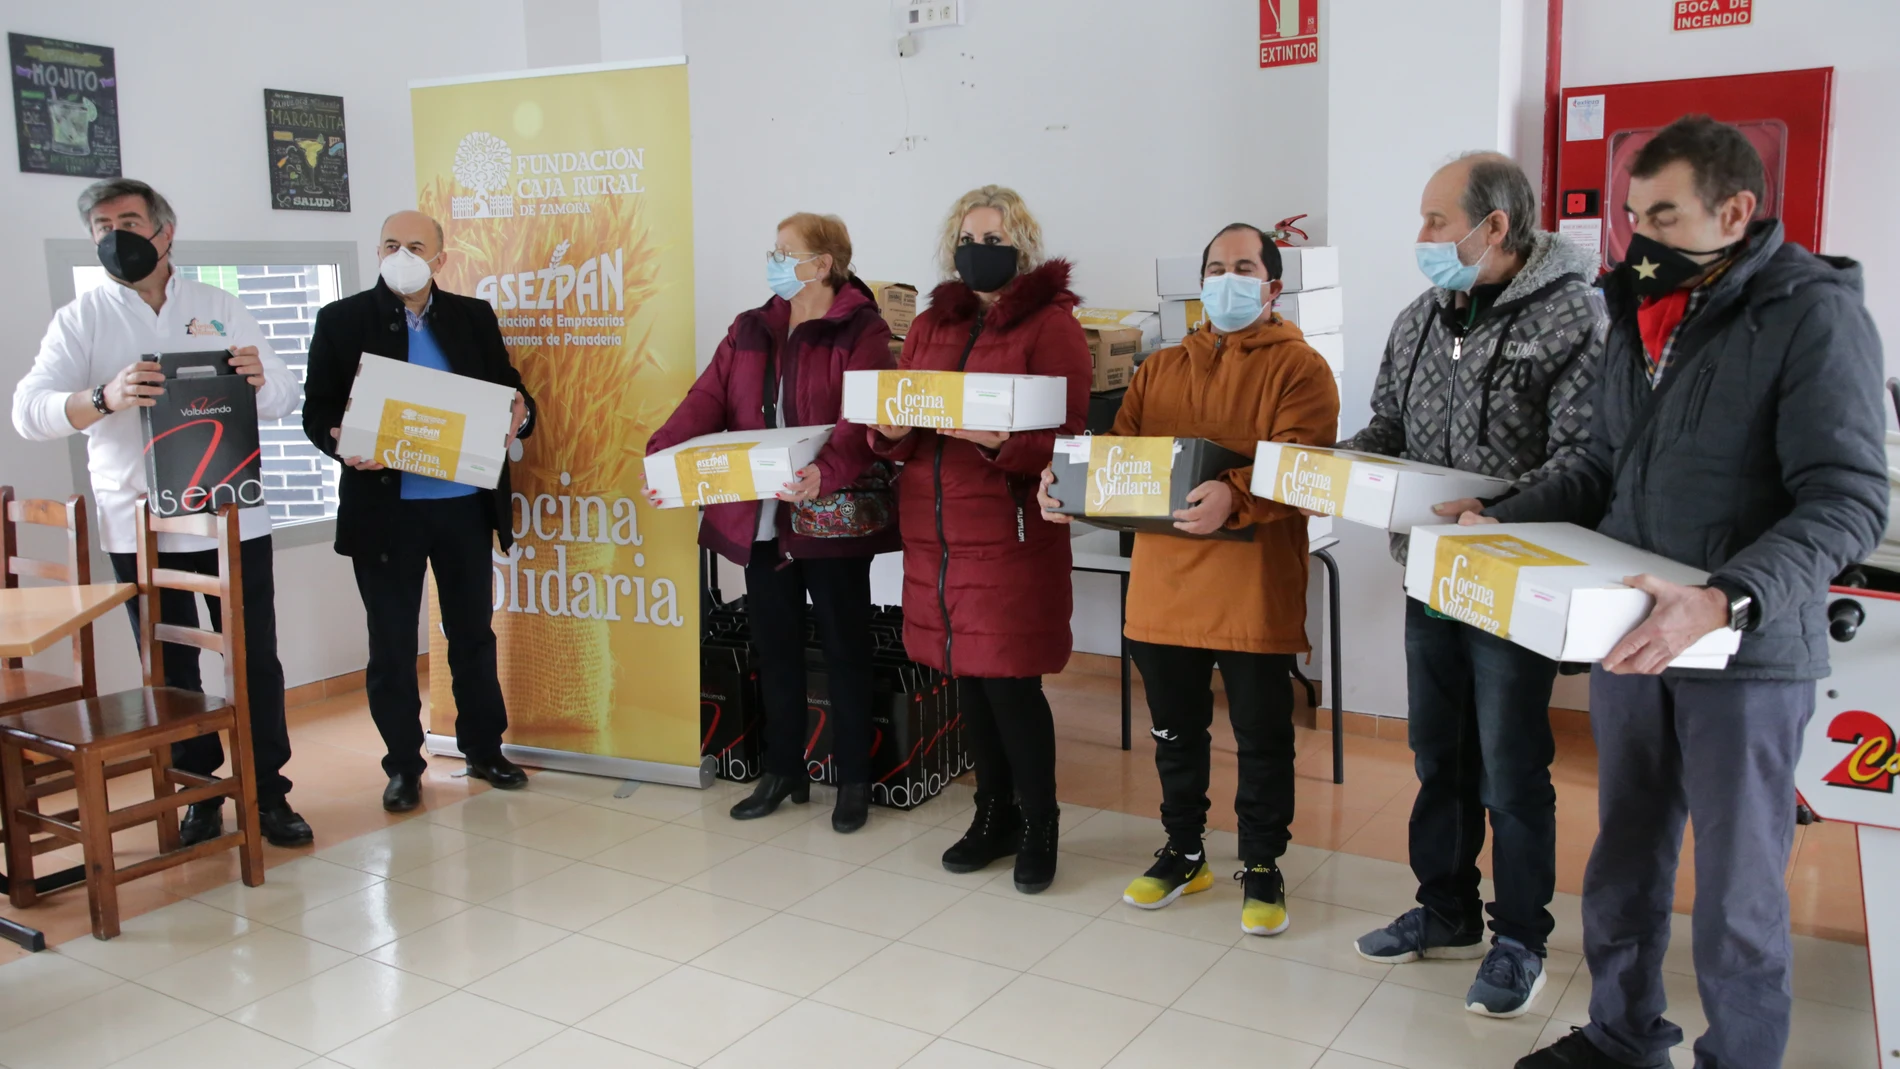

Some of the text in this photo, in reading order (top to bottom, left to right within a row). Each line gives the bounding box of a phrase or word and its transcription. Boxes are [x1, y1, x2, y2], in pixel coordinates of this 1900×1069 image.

[1677, 11, 1749, 29] INCENDIO
[1678, 0, 1749, 14] BOCA DE
[1261, 42, 1317, 63] EXTINTOR
[32, 63, 98, 92] MOJITO
[270, 109, 344, 130] MARGARITA
[516, 148, 645, 175] FUNDACIÓN
[517, 174, 645, 200] CAJA RURAL
[293, 196, 335, 208] SALUD!
[520, 202, 591, 216] DE ZAMORA
[539, 314, 553, 328] de
[557, 314, 625, 330] Empresarios
[546, 333, 560, 346] de
[897, 377, 944, 414] Cocina
[180, 404, 232, 417] Valbusenda
[885, 397, 954, 429] Solidaria
[383, 449, 448, 479] Solidaria
[394, 439, 440, 465] Cocina
[1107, 446, 1152, 483] Cocina
[1291, 451, 1332, 491] Cocina
[1093, 467, 1162, 509] Solidaria
[1281, 471, 1336, 516] Solidaria
[508, 458, 643, 547] ocina
[492, 543, 684, 628] olidaria
[1449, 554, 1495, 607] Cocina
